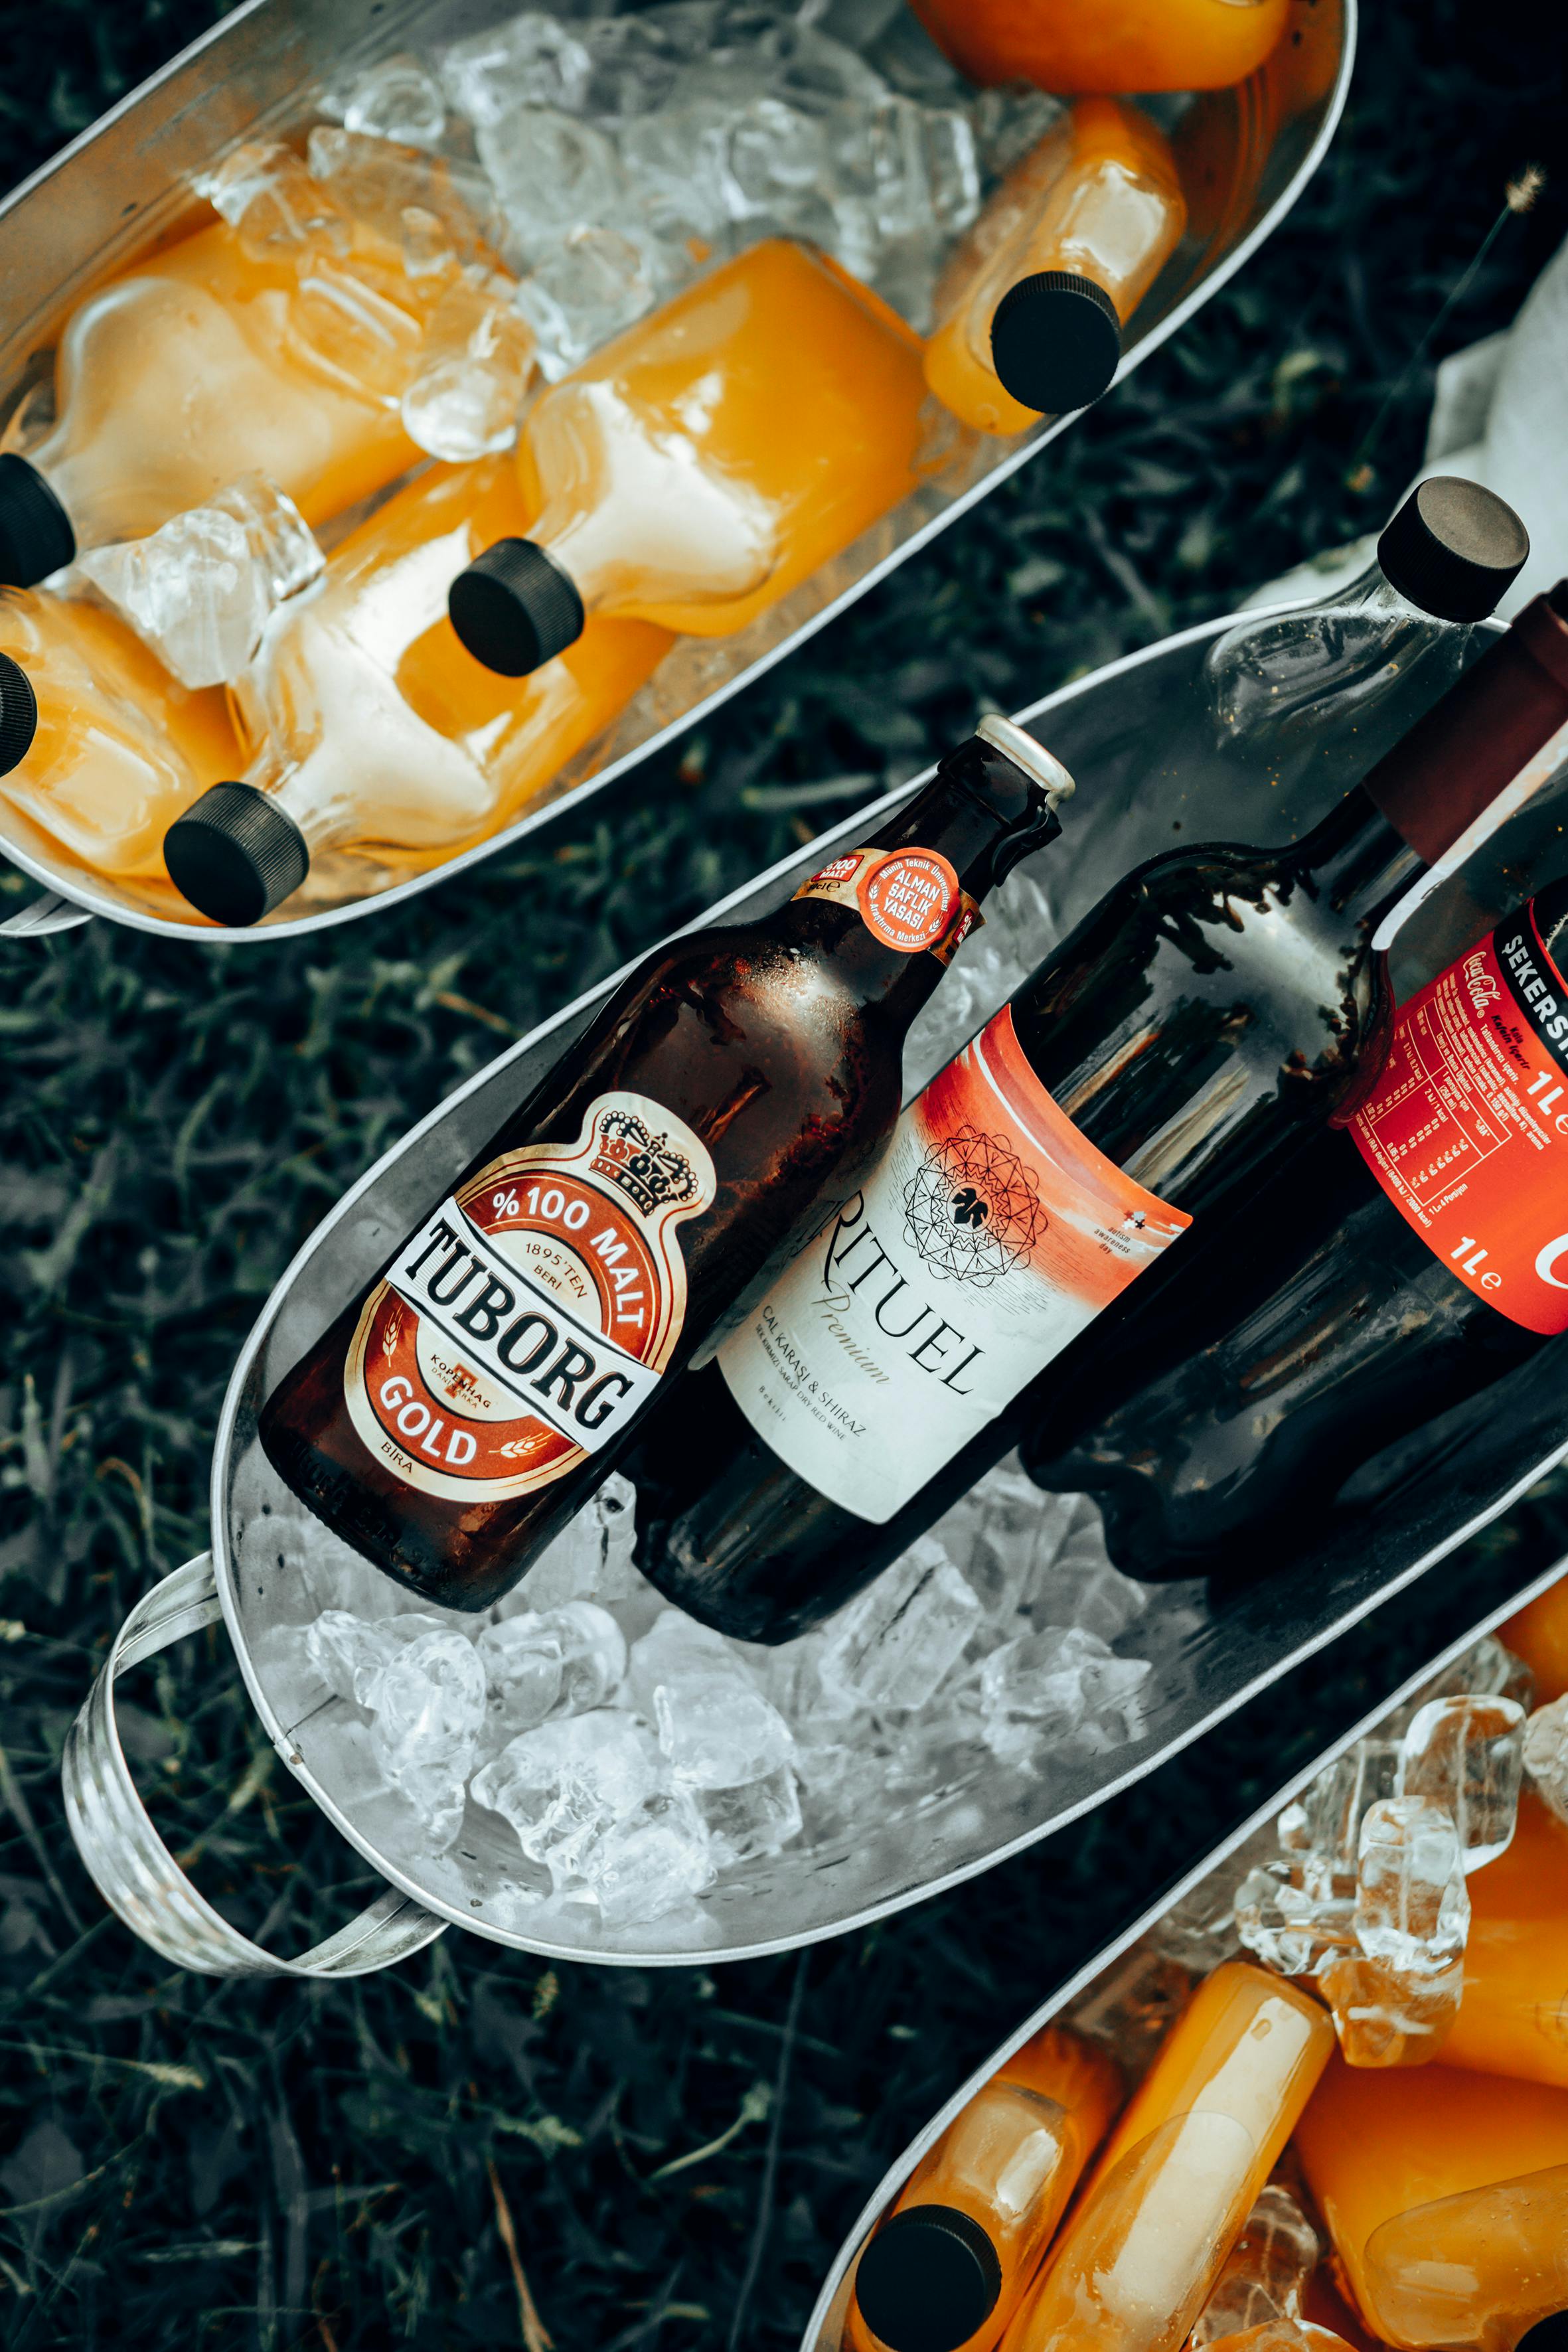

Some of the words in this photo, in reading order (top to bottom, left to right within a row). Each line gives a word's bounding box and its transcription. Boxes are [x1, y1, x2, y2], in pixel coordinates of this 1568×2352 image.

[819, 870, 847, 878] MALT
[880, 862, 903, 879] Münih
[905, 858, 930, 870] Teknik
[931, 865, 950, 912] Üniversitesi
[894, 870, 940, 902] ALMAN
[884, 897, 925, 929] YASASI
[888, 883, 933, 915] SAFLIK
[870, 903, 895, 936] Araştırma
[897, 931, 925, 942] Merkezi
[1502, 935, 1568, 1060] ŞEKERS
[1491, 1015, 1512, 1044] Kafein
[1437, 1032, 1447, 1048] Enerji
[1447, 1054, 1458, 1071] Besin
[1464, 1056, 1476, 1073] kafein
[1094, 1229, 1131, 1253] awareness
[1099, 1243, 1113, 1254] day
[1108, 1227, 1131, 1243] autism
[493, 1186, 590, 1230] %100
[589, 1227, 645, 1328] MALT
[823, 1189, 986, 1395] RITUEL
[404, 1216, 635, 1430] TUBORG
[811, 1280, 892, 1385] Premium
[430, 1354, 491, 1409] KOPENHAG
[762, 1338, 780, 1368] KIRMIZI
[797, 1391, 813, 1407] DRY
[811, 1407, 826, 1423] RED
[827, 1421, 847, 1441] WINE
[380, 1376, 477, 1465] GOLD
[809, 1381, 819, 1394] &
[819, 1391, 866, 1437] SHIRAZ
